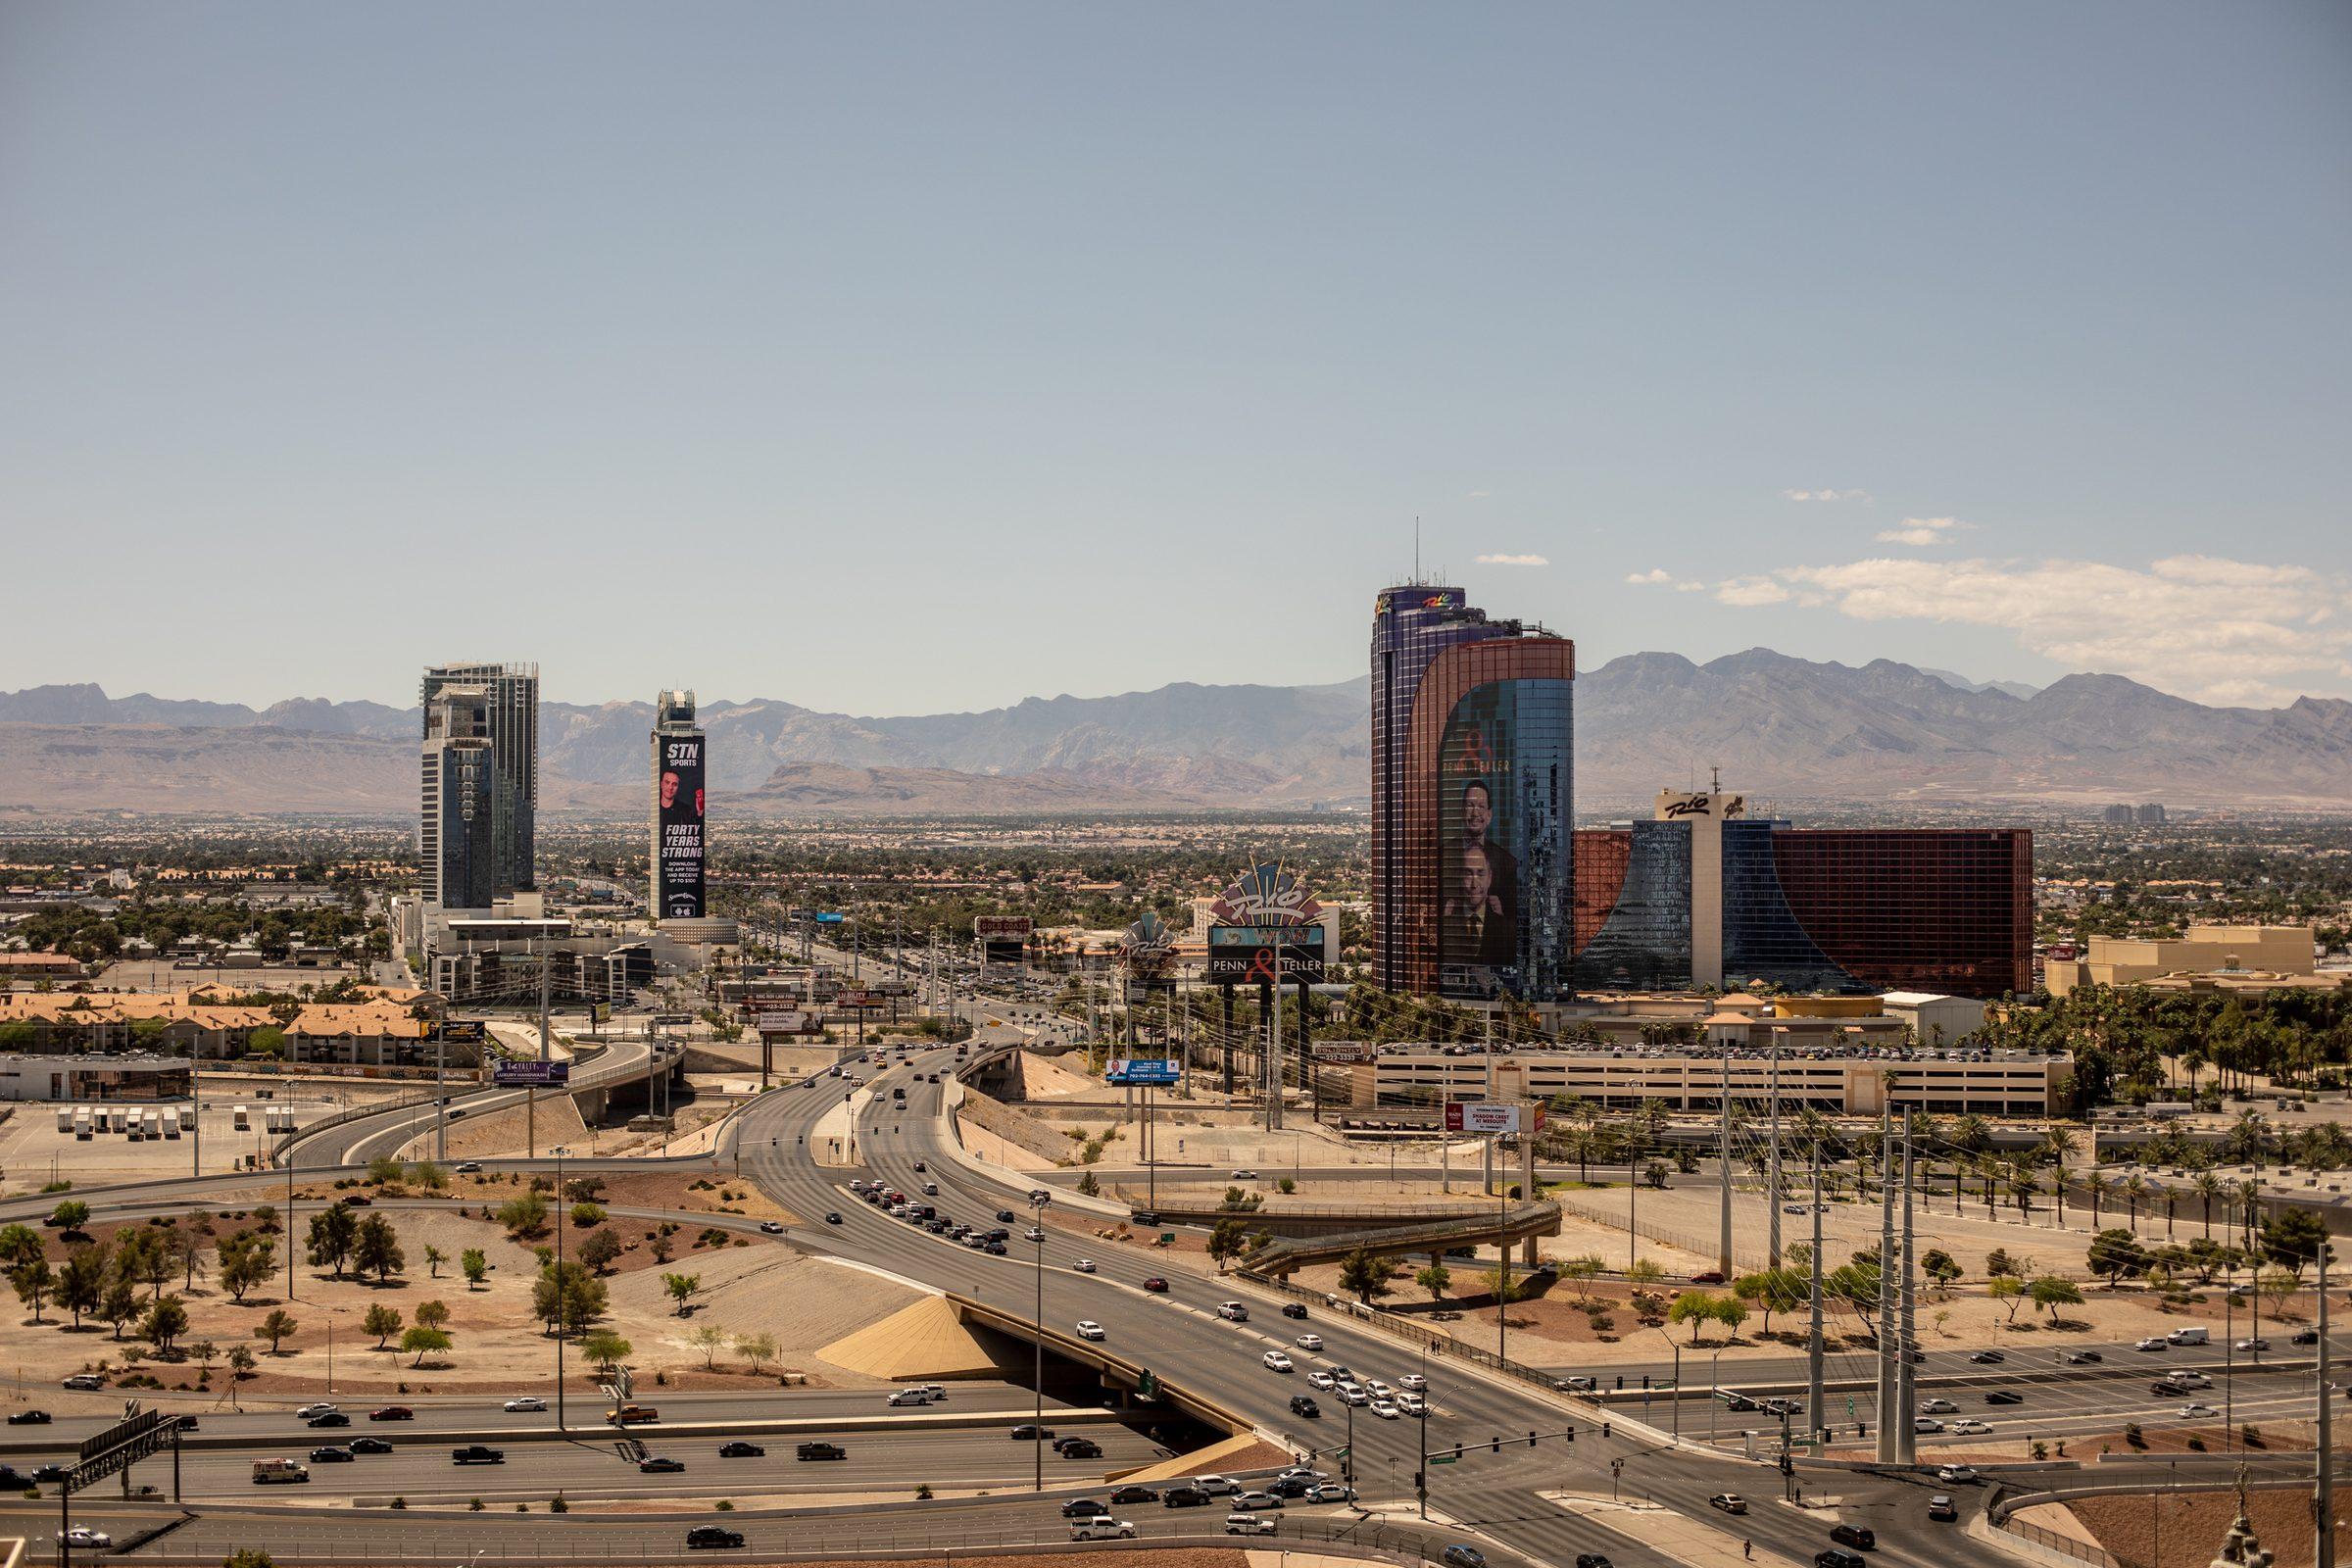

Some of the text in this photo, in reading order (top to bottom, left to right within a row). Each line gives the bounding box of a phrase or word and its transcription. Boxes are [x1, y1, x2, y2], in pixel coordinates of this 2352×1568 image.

[667, 743, 698, 759] STN
[1665, 796, 1710, 819] Rio
[666, 825, 700, 835] FORTY
[666, 836, 700, 846] YEARS
[662, 847, 703, 858] STRONG
[1225, 886, 1305, 920] Rio
[1129, 937, 1172, 956] Rio
[1214, 961, 1247, 971] PENN
[1283, 960, 1322, 971] TELLER
